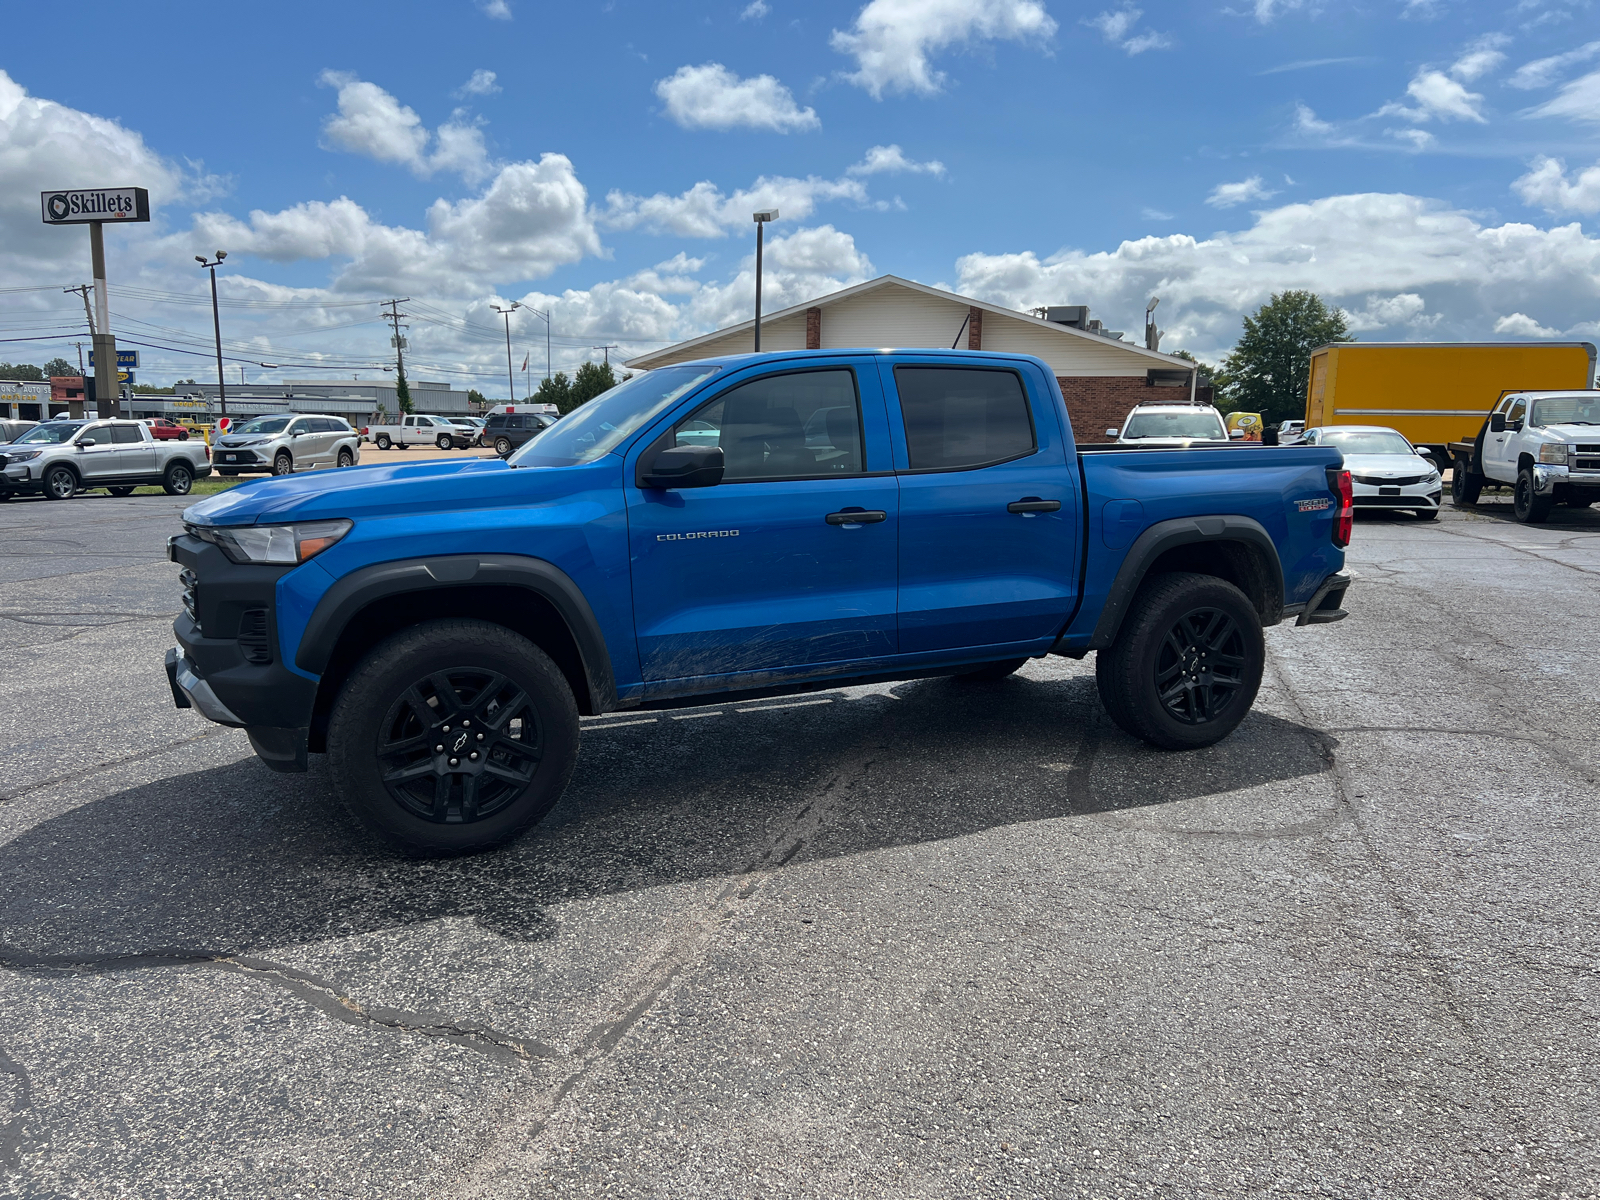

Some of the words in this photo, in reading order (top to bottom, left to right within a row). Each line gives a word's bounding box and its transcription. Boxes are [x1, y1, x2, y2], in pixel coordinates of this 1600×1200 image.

[70, 192, 132, 214] Skillets
[23, 386, 41, 394] AUTO
[1294, 498, 1333, 507] TRAIL
[1299, 504, 1328, 512] BOSS
[656, 529, 740, 542] COLORADO
